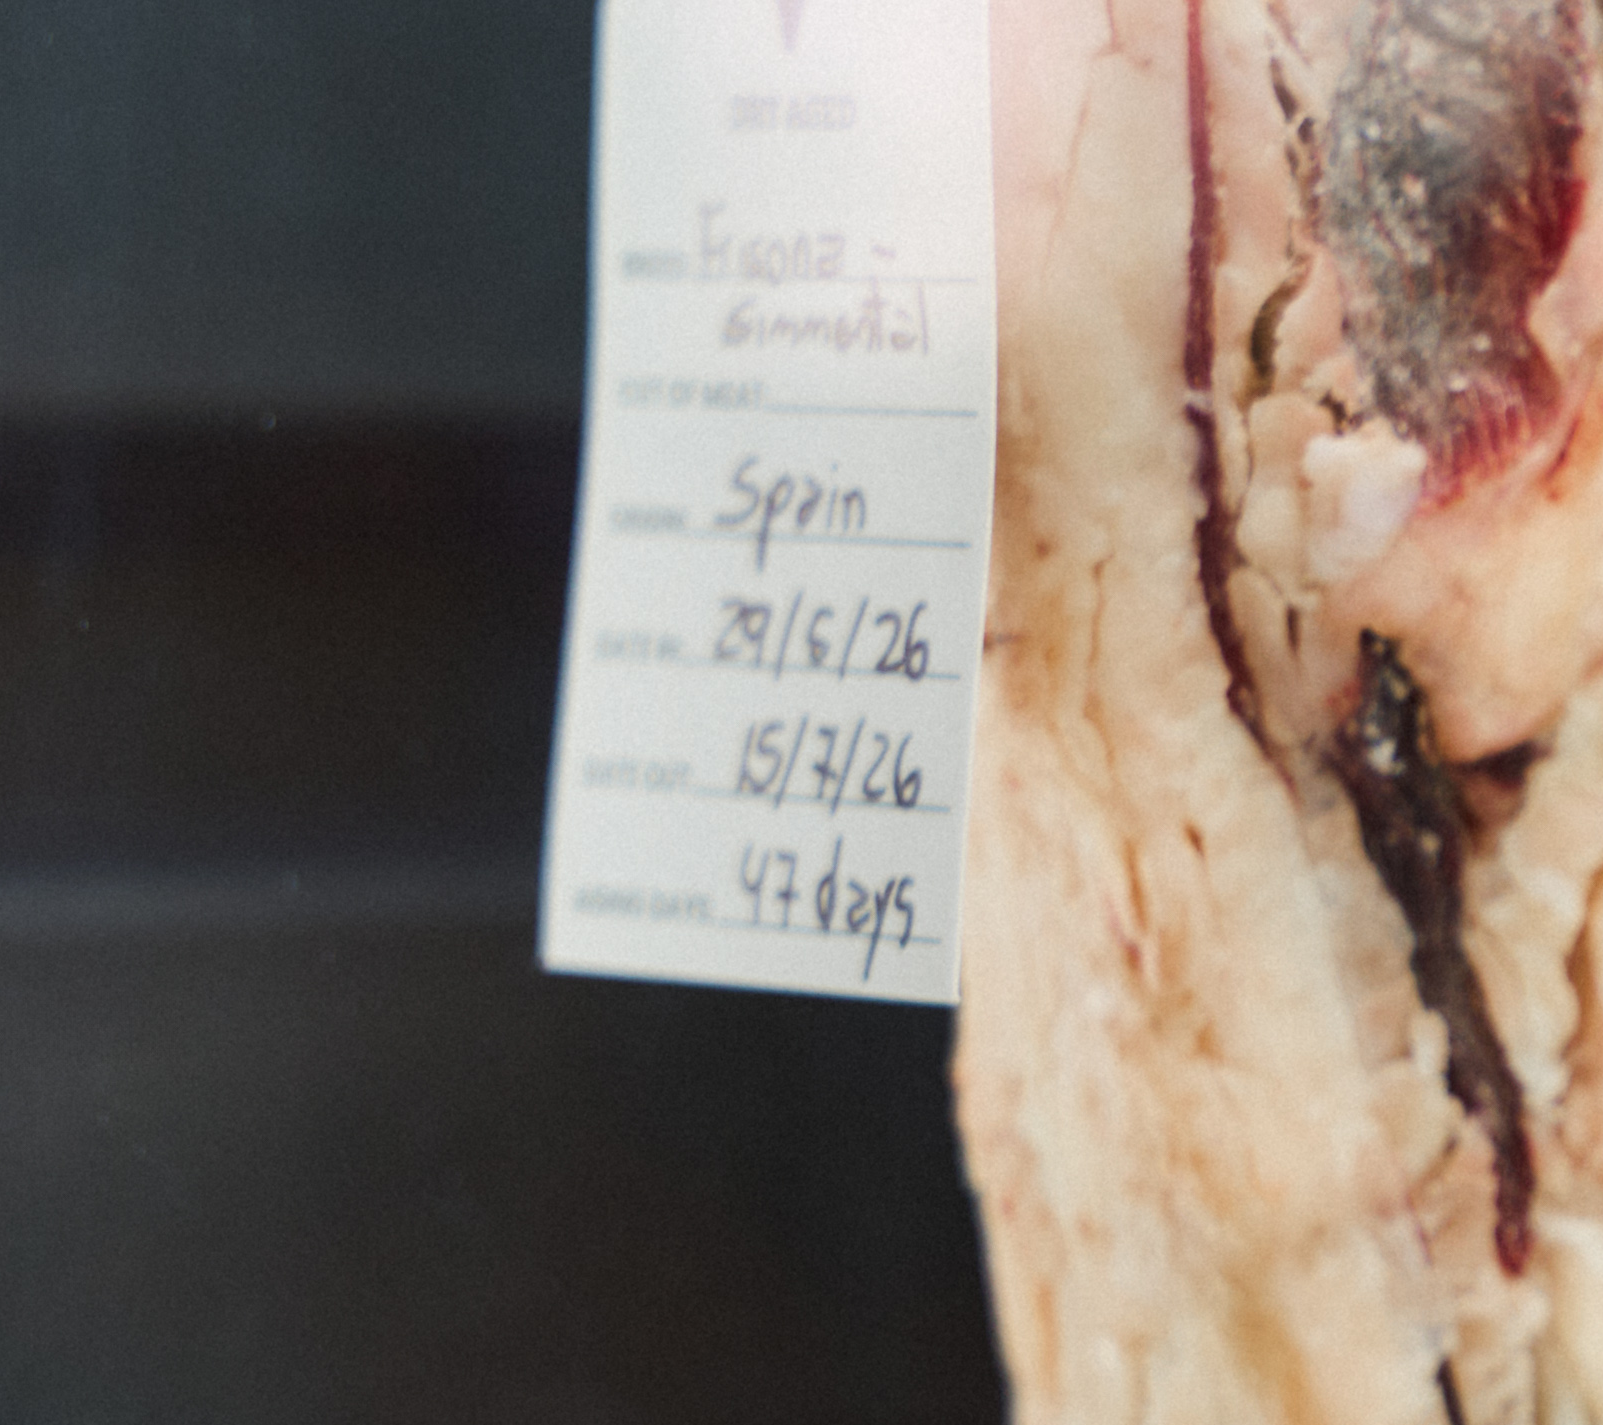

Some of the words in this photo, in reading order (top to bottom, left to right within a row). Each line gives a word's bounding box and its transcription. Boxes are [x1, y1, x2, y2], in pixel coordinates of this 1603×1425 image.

[714, 454, 869, 572] Spain
[736, 715, 922, 814] 15/7/26
[739, 840, 800, 929] 47
[815, 834, 915, 982] days
